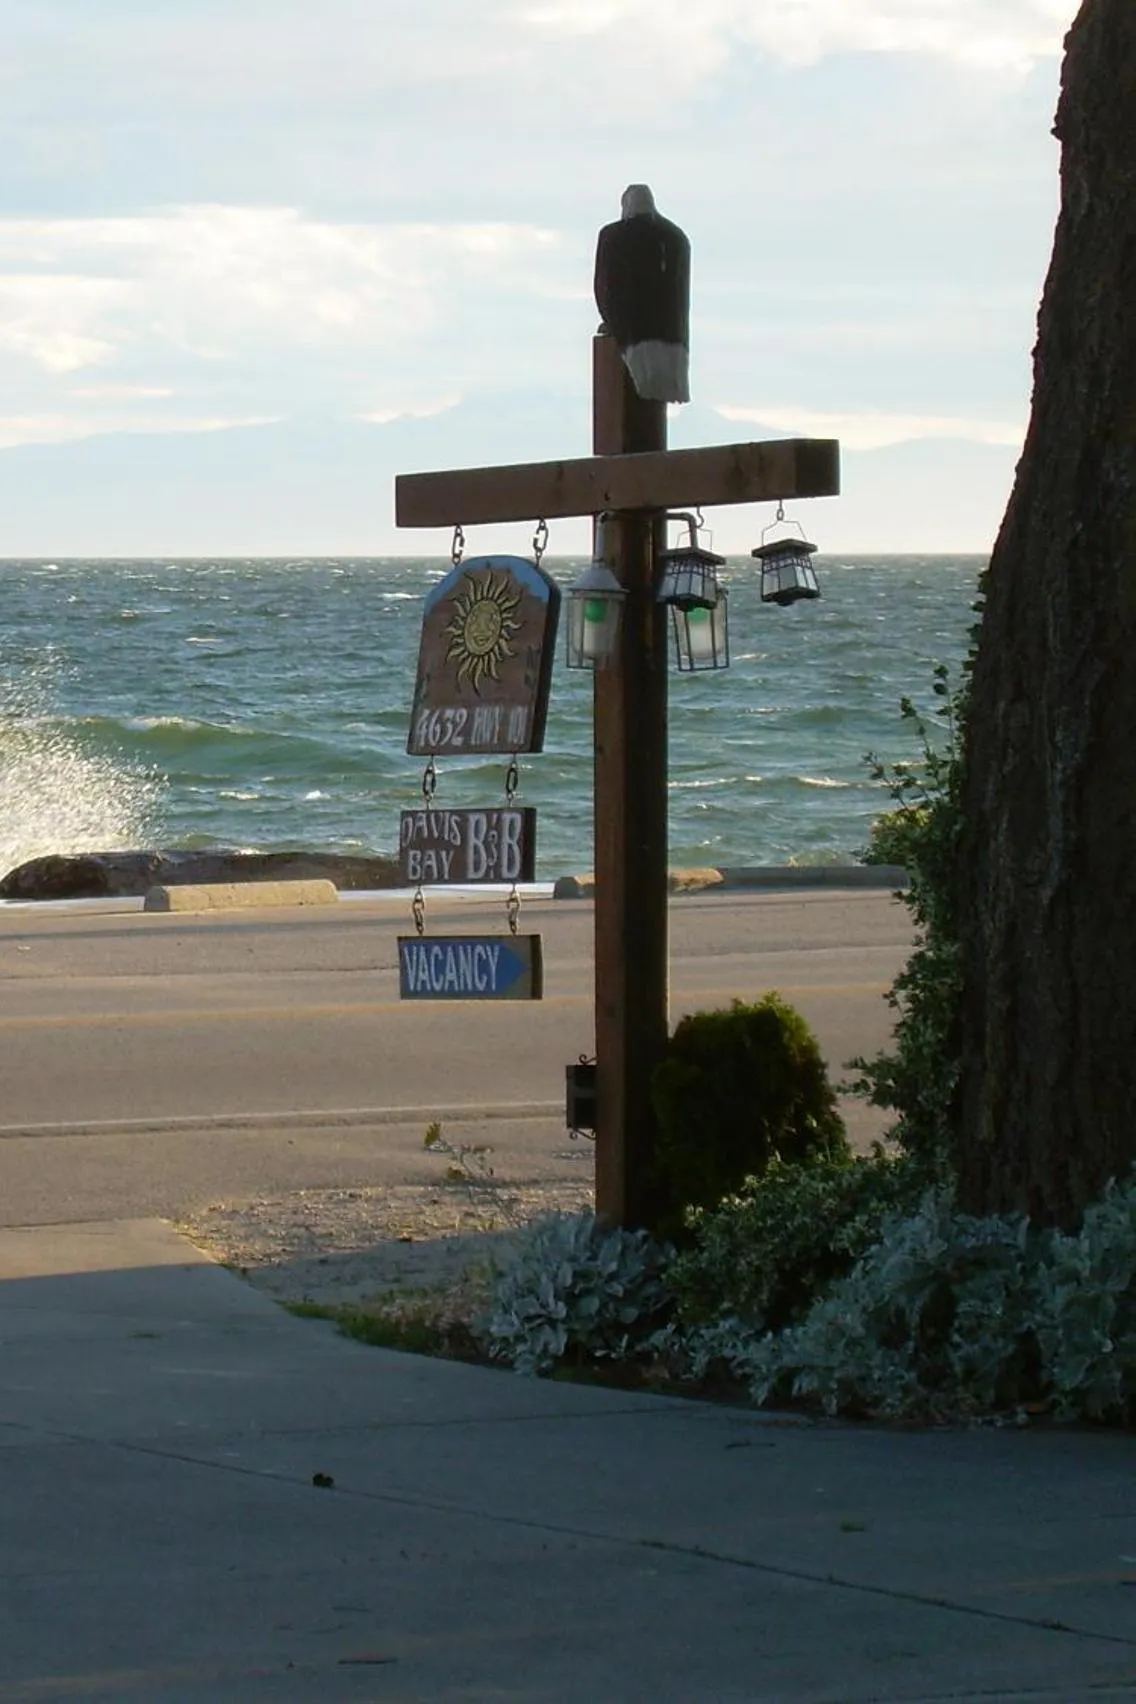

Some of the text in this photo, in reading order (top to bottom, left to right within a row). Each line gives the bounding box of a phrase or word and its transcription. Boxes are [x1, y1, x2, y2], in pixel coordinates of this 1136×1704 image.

[402, 812, 461, 847] DAVIS
[407, 850, 455, 881] BAY
[403, 944, 501, 992] VACANCY
